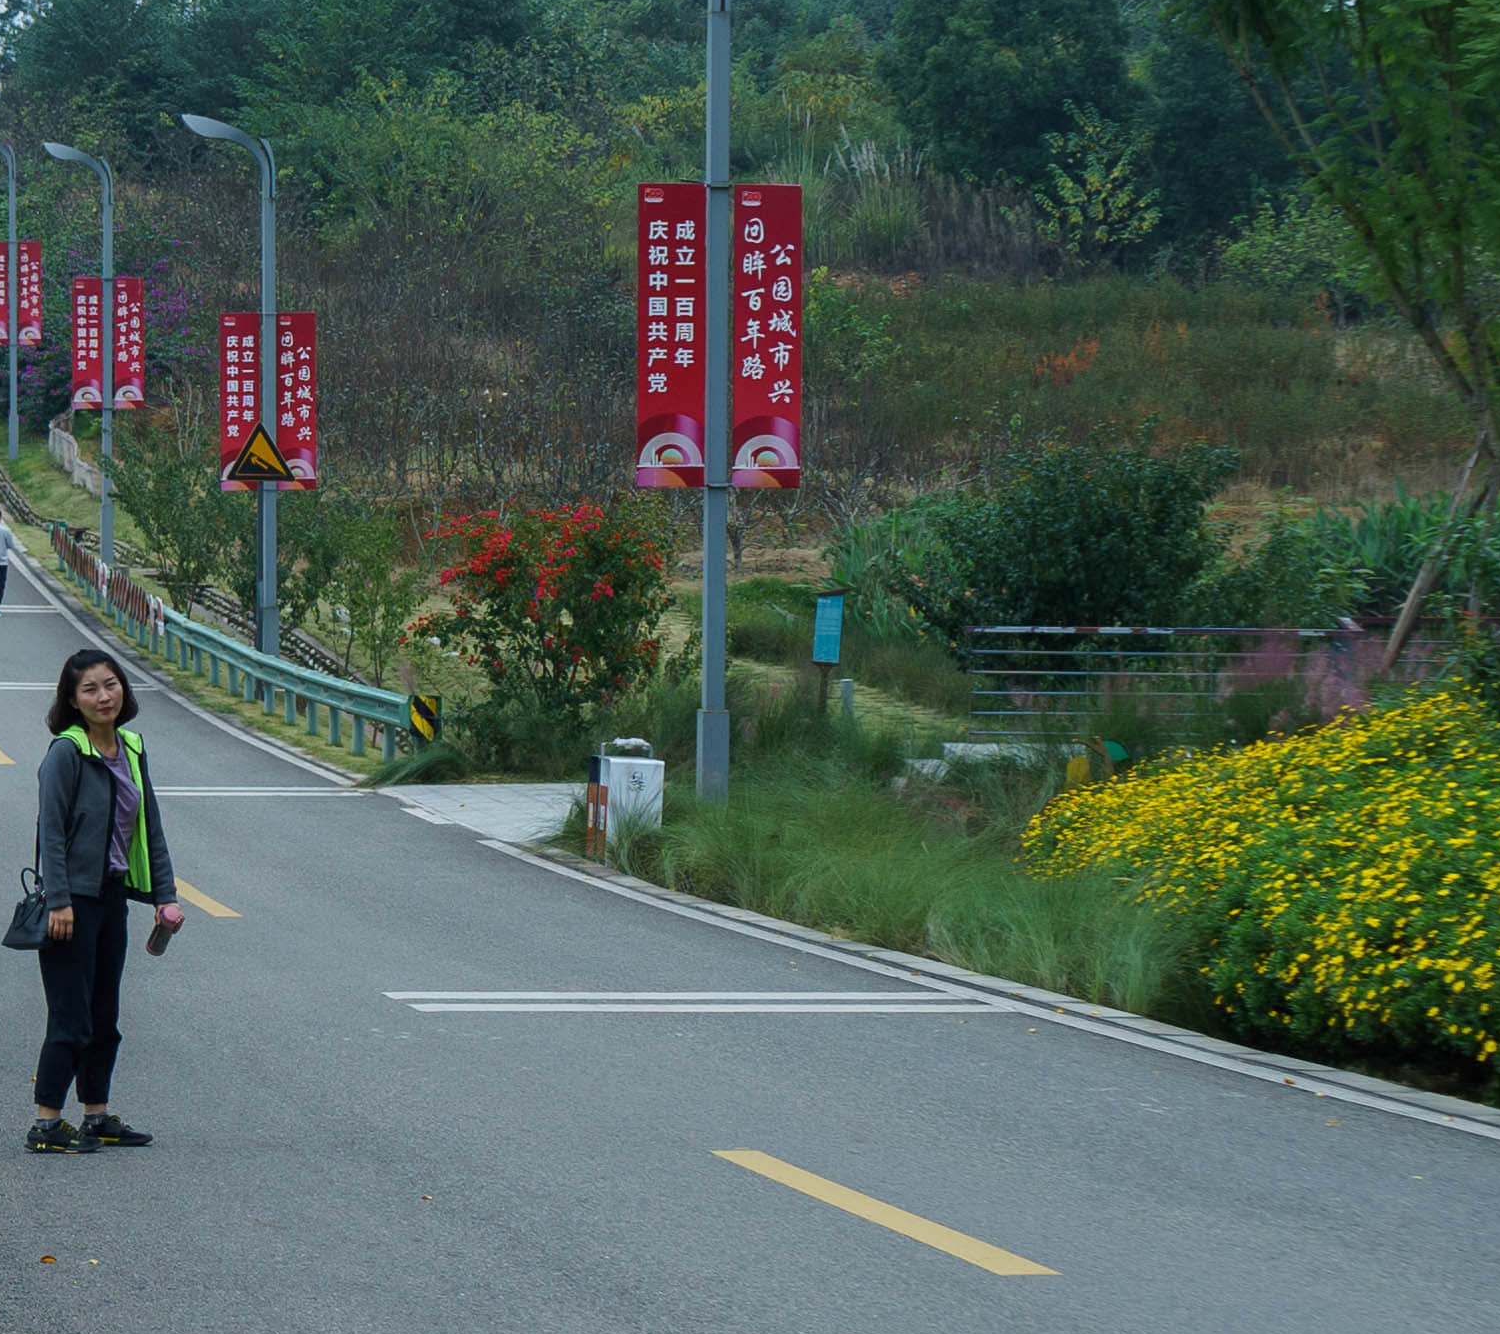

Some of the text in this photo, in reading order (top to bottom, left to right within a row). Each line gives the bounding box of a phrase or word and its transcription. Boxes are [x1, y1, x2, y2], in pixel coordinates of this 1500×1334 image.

[648, 220, 669, 394] 庆祝中国共产党
[674, 220, 696, 368] 成立一百周年
[741, 218, 767, 380] 回眸百年路
[768, 244, 797, 404] 公园城市兴
[226, 335, 240, 438] 庆祝中国共产党
[241, 335, 255, 423] 成立一百周年
